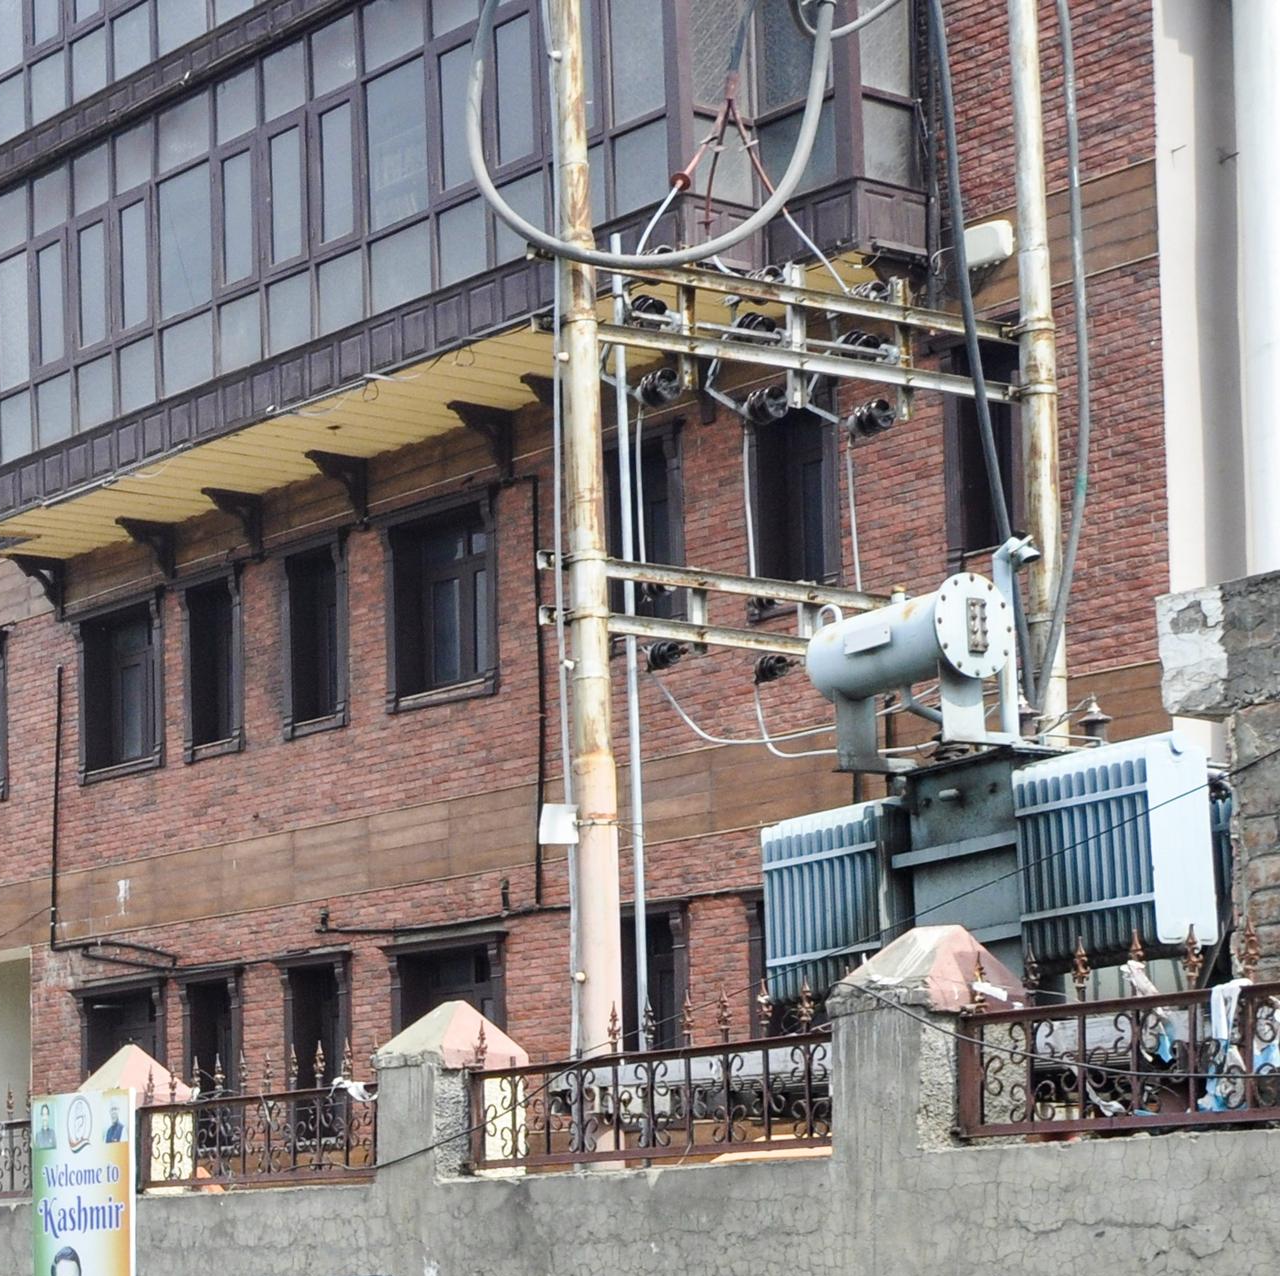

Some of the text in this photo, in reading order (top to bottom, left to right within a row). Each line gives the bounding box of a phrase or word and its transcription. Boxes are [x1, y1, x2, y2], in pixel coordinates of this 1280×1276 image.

[42, 1163, 119, 1189] Welcome to
[39, 1195, 124, 1239] Kashmir
